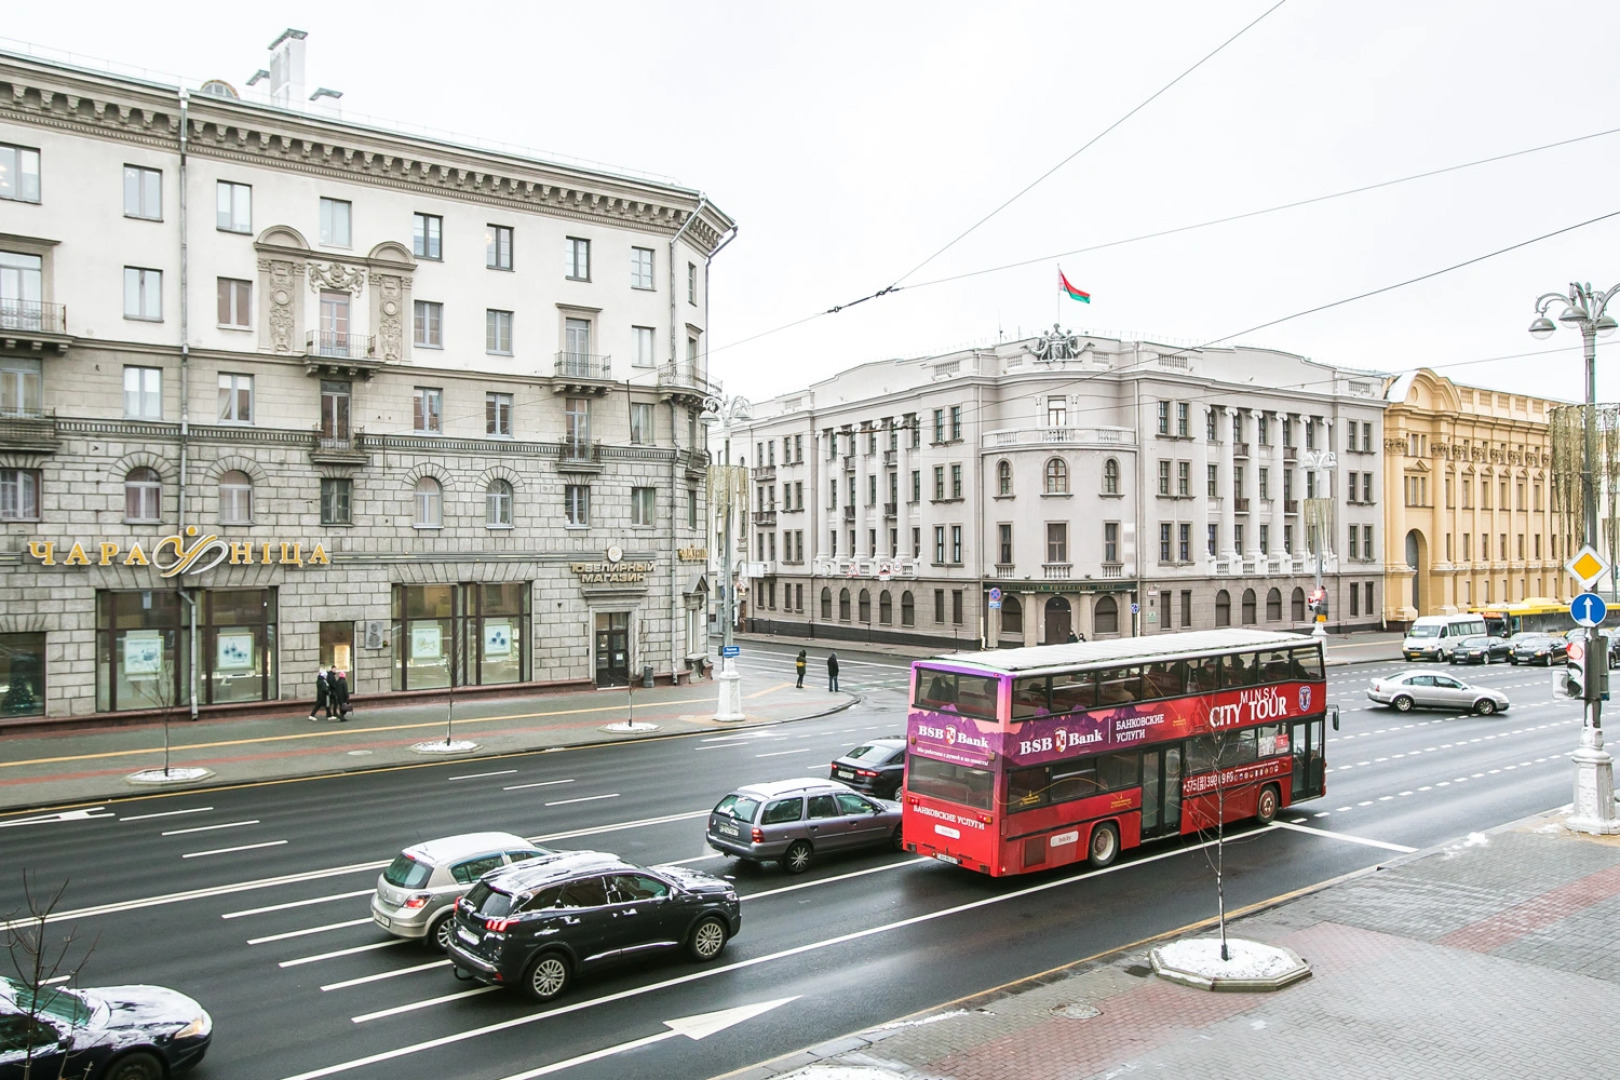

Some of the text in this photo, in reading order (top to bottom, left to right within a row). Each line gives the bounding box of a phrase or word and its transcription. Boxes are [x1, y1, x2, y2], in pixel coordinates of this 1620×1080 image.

[571, 561, 657, 574] ЮВЕЛИРНЫЙ
[581, 572, 647, 583] МАГАЗИН
[1240, 686, 1278, 704] MINSK
[1209, 696, 1288, 728] CITY TOUR
[1116, 713, 1165, 730] БАНКОВСКИЕ
[918, 725, 989, 748] BSB Bank
[1019, 728, 1103, 756] BSB Bank
[1116, 729, 1146, 743] УСЛУГИ
[913, 804, 985, 830] БАНКОВСКИЕ УСЛУГИ
